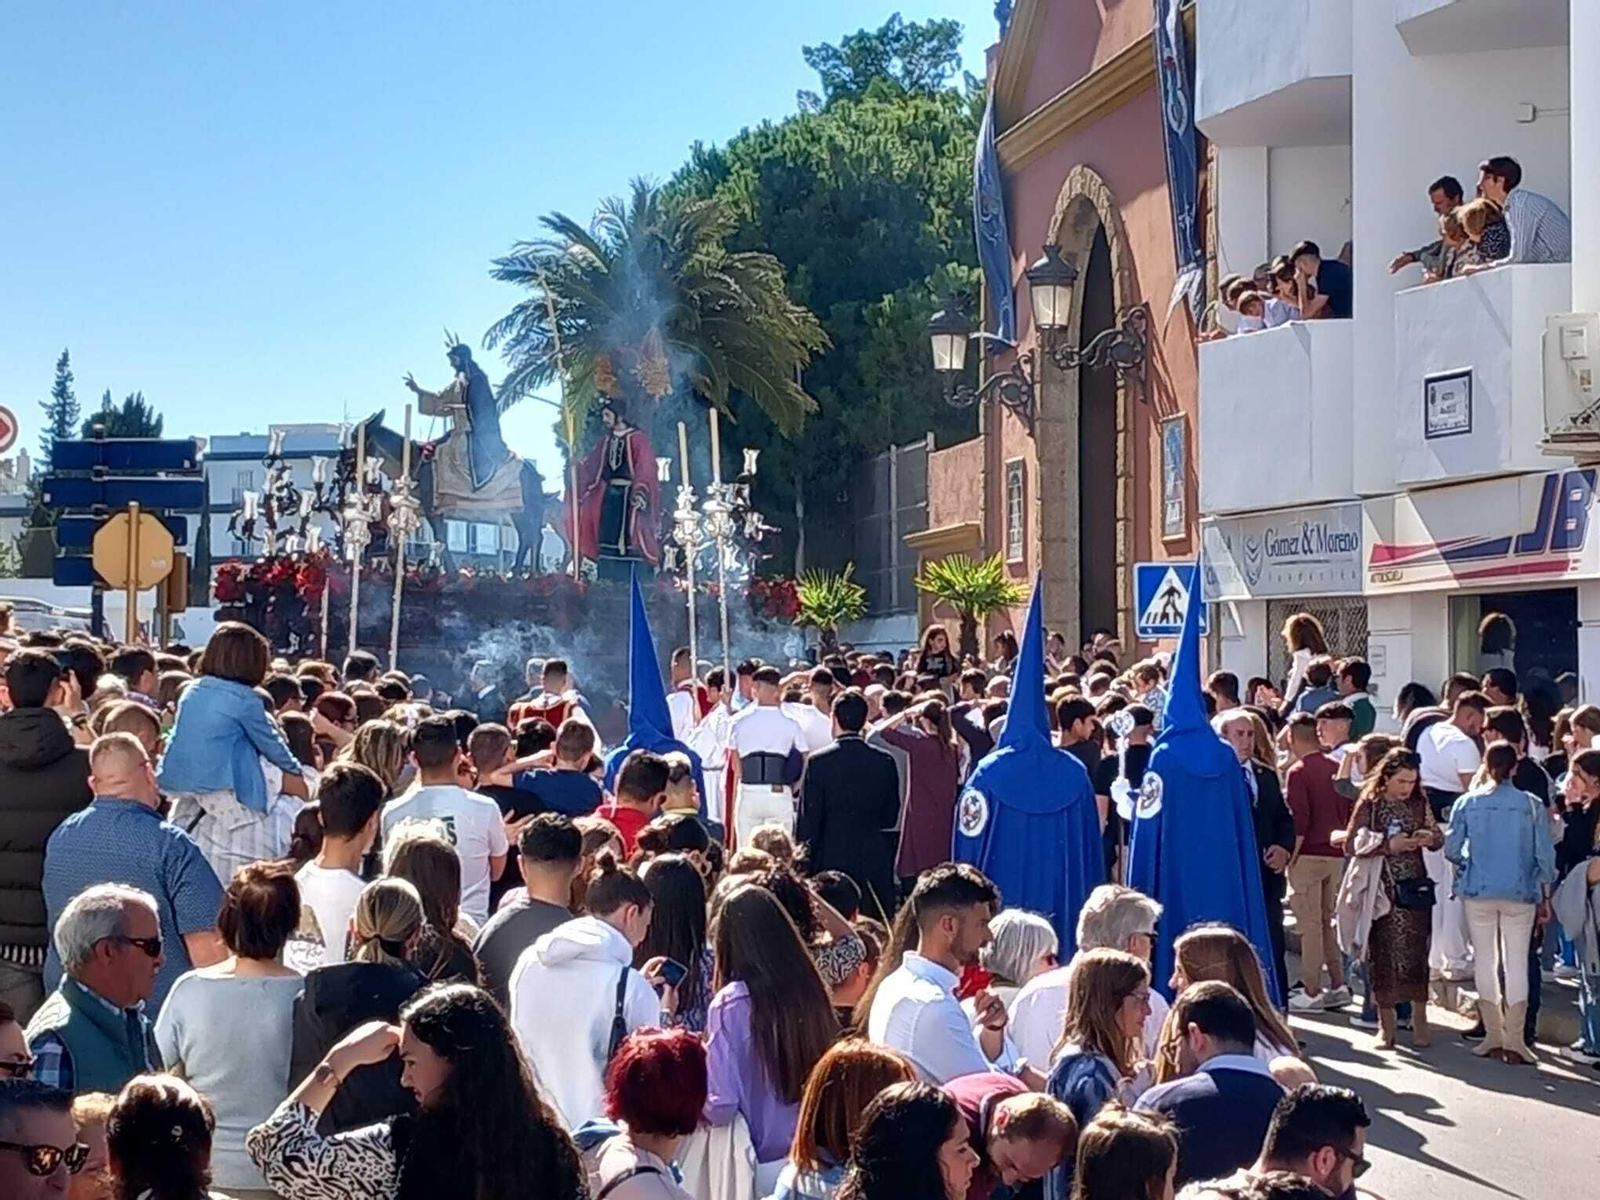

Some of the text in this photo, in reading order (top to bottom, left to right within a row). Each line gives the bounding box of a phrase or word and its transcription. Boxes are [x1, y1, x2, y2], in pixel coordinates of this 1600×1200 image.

[1264, 527, 1300, 558] Gómez
[1301, 520, 1315, 555] &
[1316, 522, 1358, 554] Moreno
